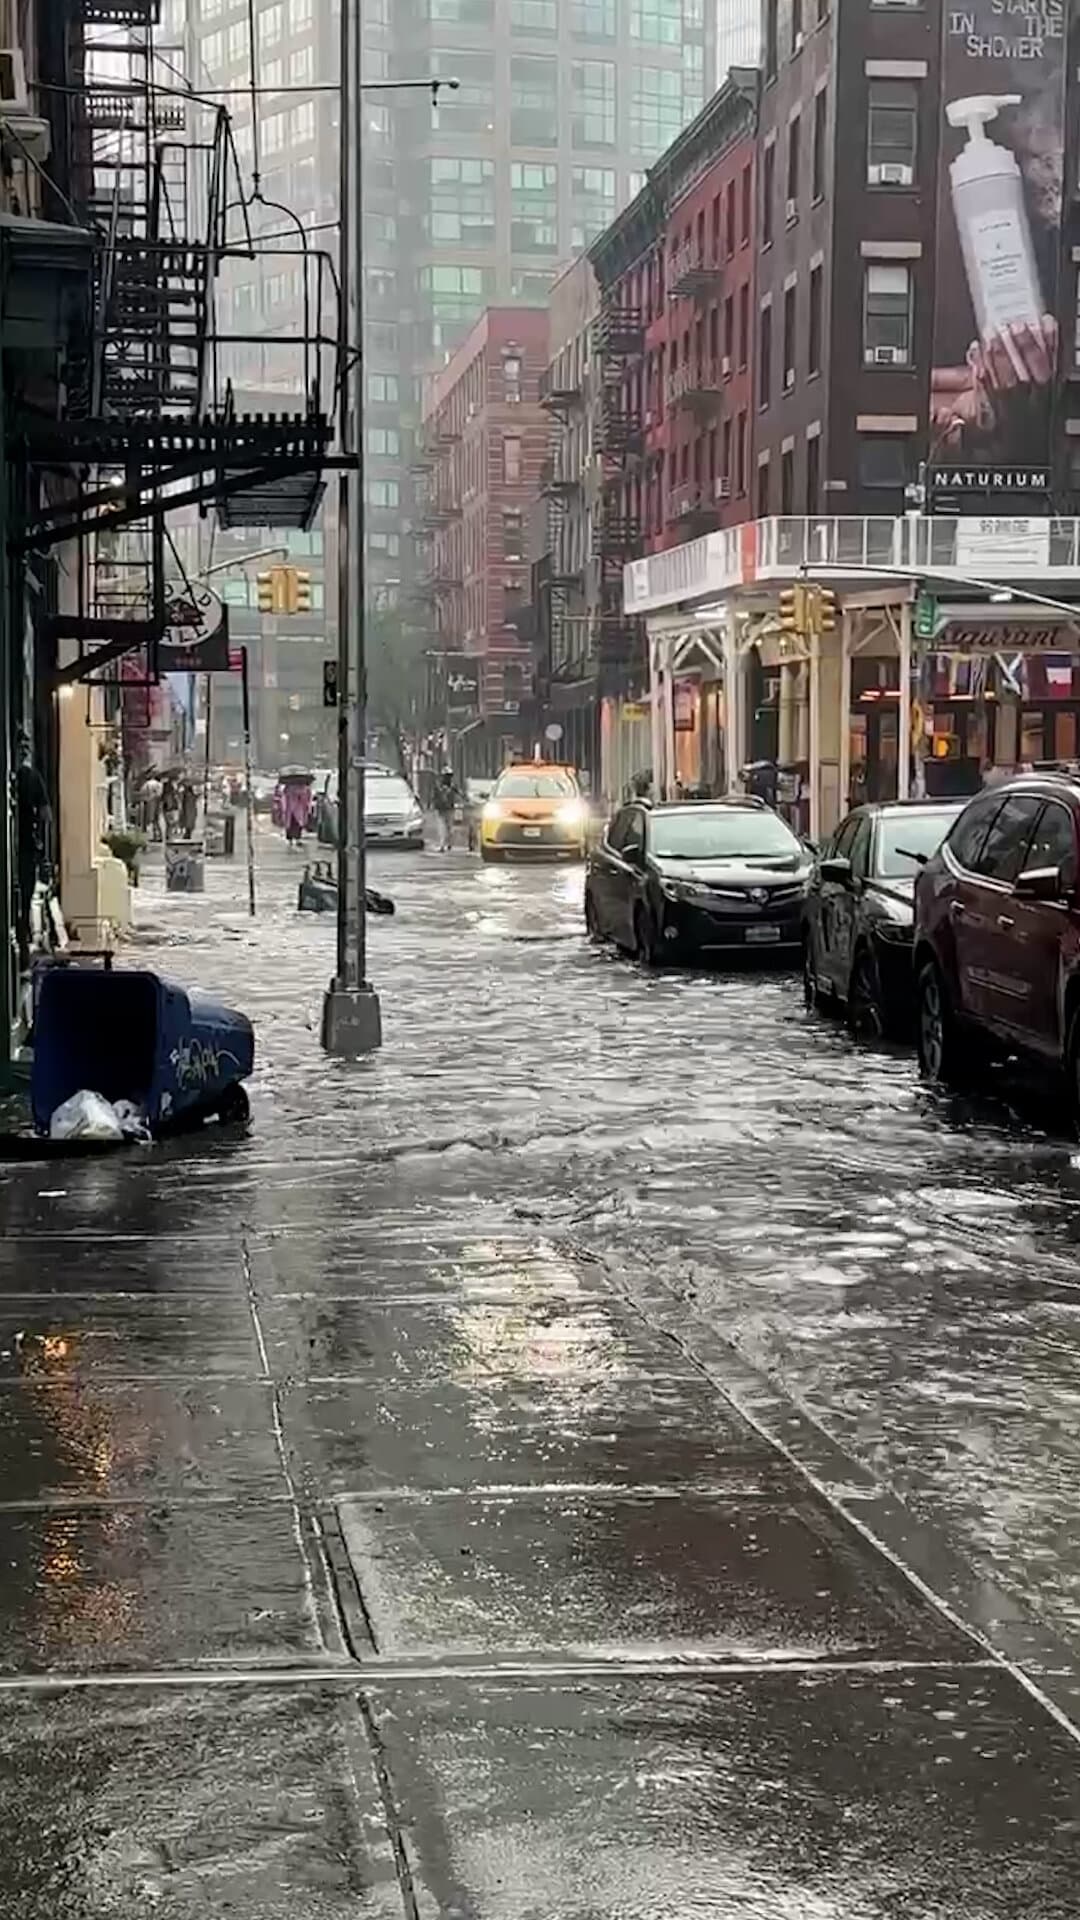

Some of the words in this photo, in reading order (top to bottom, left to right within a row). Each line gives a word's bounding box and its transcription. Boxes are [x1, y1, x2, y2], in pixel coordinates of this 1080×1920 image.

[949, 11, 975, 34] IN
[1023, 15, 1063, 38] THE
[935, 472, 1046, 487] NATURIUM
